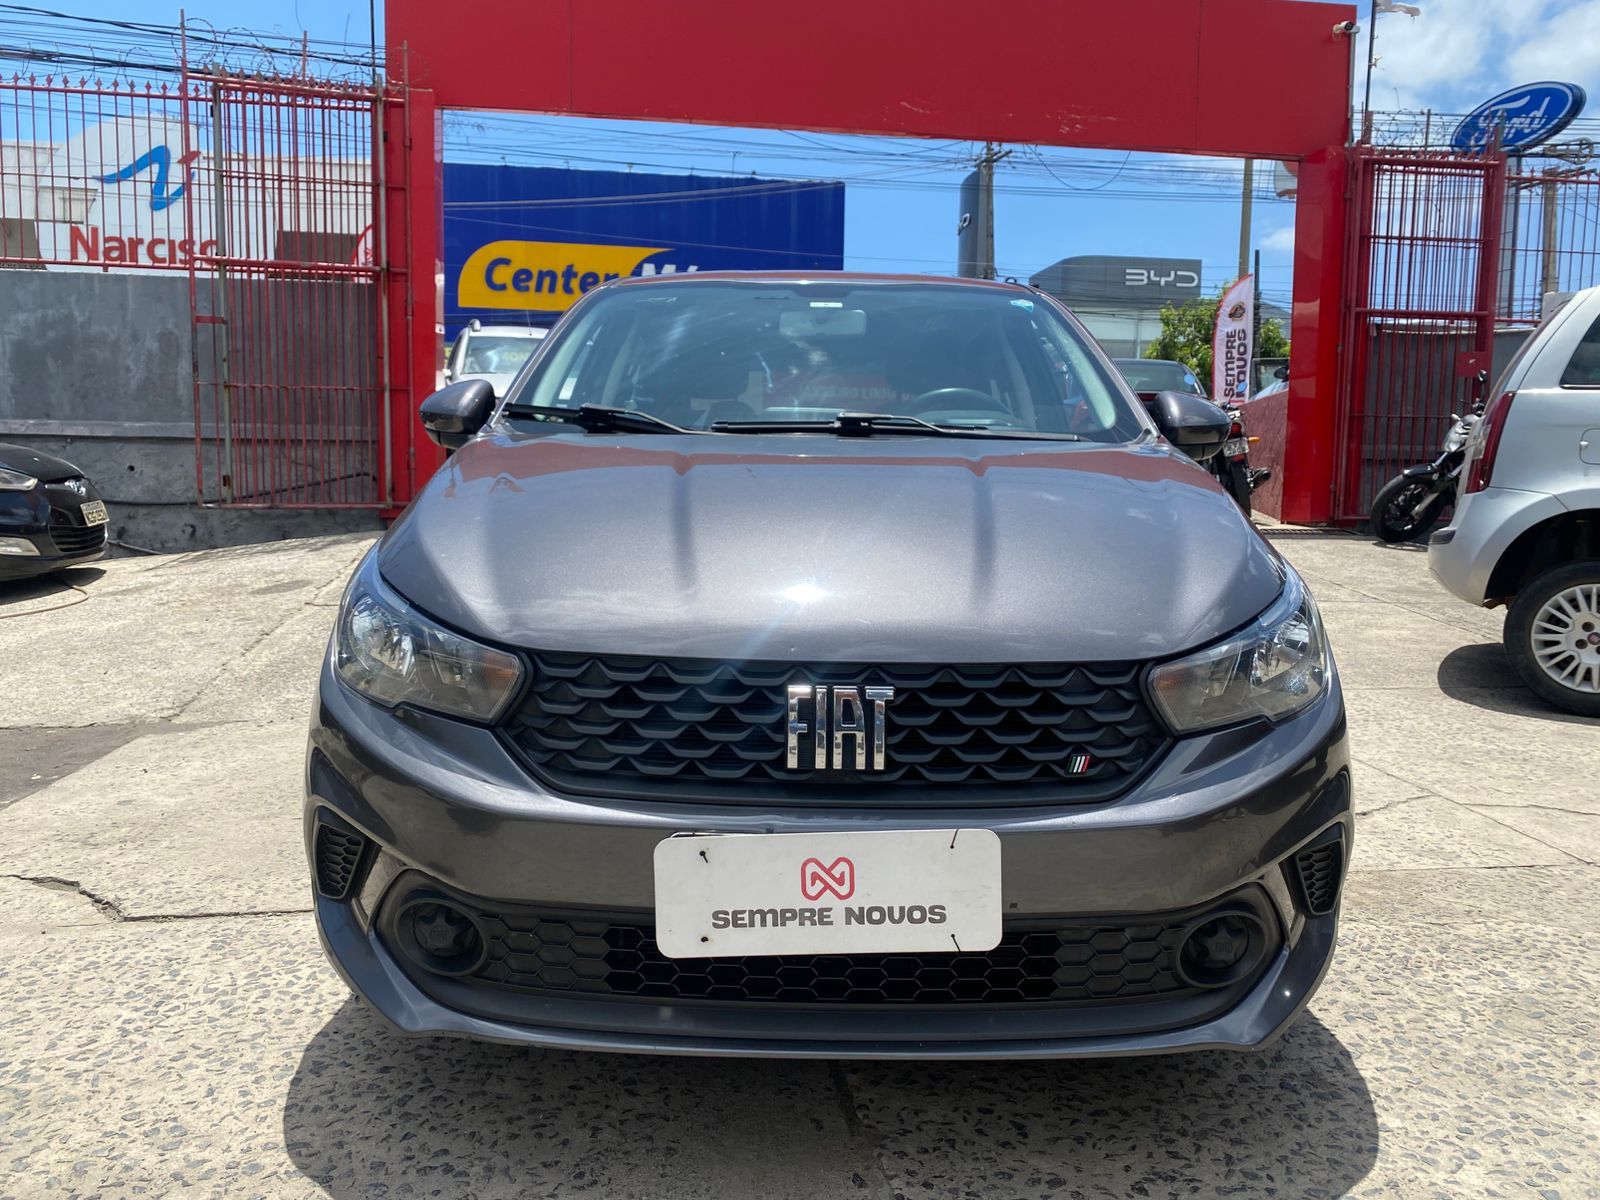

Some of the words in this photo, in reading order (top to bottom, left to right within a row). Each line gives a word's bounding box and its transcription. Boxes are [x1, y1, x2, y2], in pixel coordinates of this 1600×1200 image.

[70, 224, 219, 266] Narciso
[1125, 268, 1199, 287] BYD
[1224, 329, 1236, 397] SEMPRE
[786, 685, 896, 770] FIAT
[711, 907, 834, 929] SEMPRE
[844, 904, 947, 926] NOVOS
